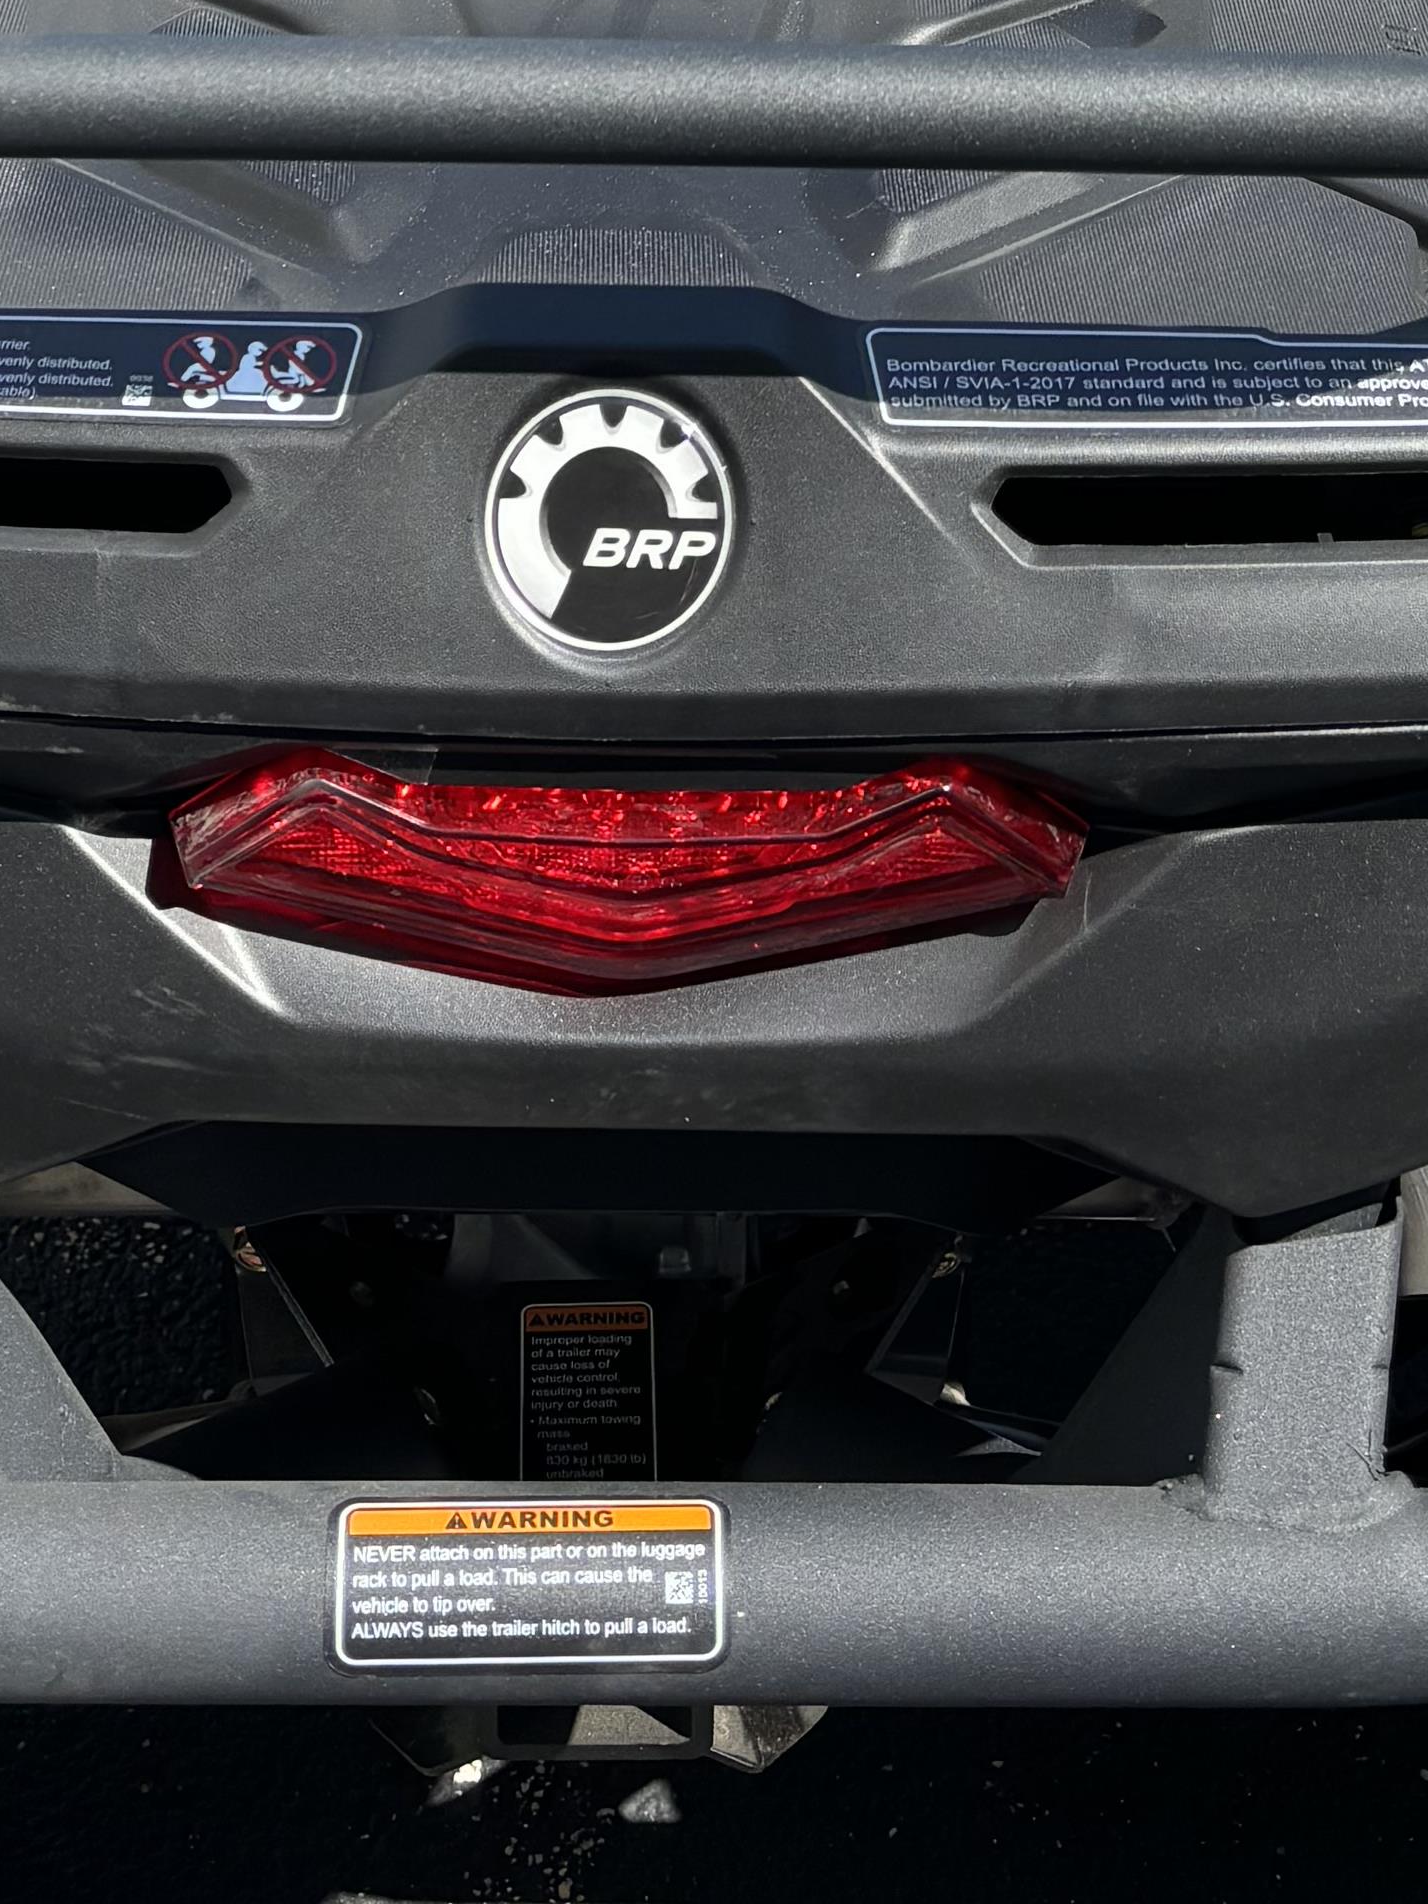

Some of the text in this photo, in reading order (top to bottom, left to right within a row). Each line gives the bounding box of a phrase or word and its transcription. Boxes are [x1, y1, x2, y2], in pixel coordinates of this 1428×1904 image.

[37, 356, 113, 371] distributed.
[886, 358, 995, 372] Bombardier
[1002, 358, 1120, 372] Recreational
[1125, 358, 1209, 372] Products
[1214, 358, 1248, 371] Inc.
[1253, 358, 1326, 371] certifies
[1331, 358, 1367, 371] that
[1372, 358, 1402, 372] this
[38, 373, 113, 388] distributed.
[888, 376, 938, 389] ANSI
[955, 376, 1076, 390] SVIA-1-2017
[1083, 376, 1165, 390] standard
[1171, 376, 1206, 389] and
[1212, 376, 1227, 389] is
[1232, 376, 1300, 391] subject
[1304, 376, 1322, 389] to
[1328, 378, 1353, 389] an
[890, 394, 983, 407] submitted
[988, 394, 1012, 411] by
[1017, 394, 1061, 407] BRP
[1066, 394, 1102, 407] and
[1107, 396, 1126, 407] on
[1137, 394, 1164, 406] file
[1171, 394, 1208, 406] with
[1213, 394, 1244, 406] the
[1251, 393, 1291, 407] U.S.
[1295, 394, 1392, 407] Consumer
[583, 527, 716, 570] BRP
[546, 1312, 645, 1326] WARNING
[471, 1509, 615, 1530] WARNING
[352, 1540, 706, 1563] NEVER attach on this part or on the luggage
[352, 1566, 654, 1592] rack to pull a load. This can cause the
[352, 1595, 496, 1617] vehicle to tip over.
[351, 1616, 692, 1640] ALWAYS use the trailer hitch to pull a load.
